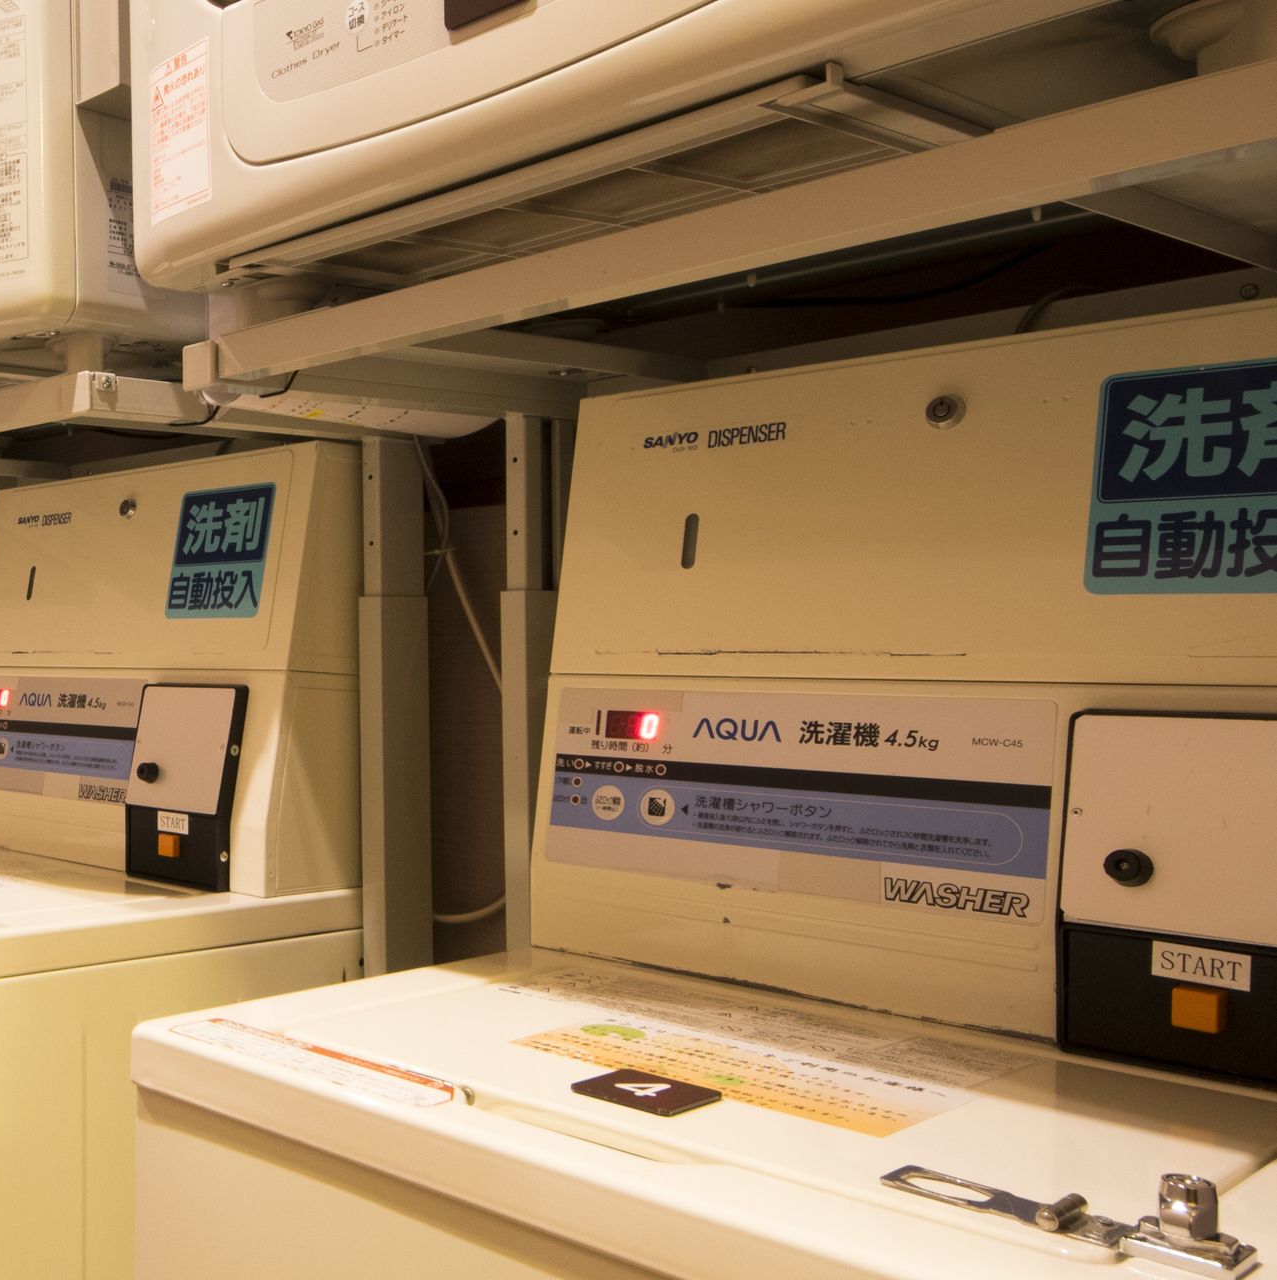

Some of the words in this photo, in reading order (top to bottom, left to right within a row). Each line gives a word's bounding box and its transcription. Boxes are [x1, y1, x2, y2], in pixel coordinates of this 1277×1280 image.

[348, 2, 365, 17] コース
[381, 3, 405, 19] アイロン
[293, 24, 312, 36] TOKYO
[313, 18, 324, 28] GAS
[381, 15, 408, 32] デリケート
[382, 30, 405, 45] タイマー
[271, 58, 308, 79] Clothes
[313, 41, 341, 60] Dryer
[643, 430, 699, 450] SANYO
[707, 422, 787, 448] DISPENSER
[17, 515, 40, 526] SANYO
[41, 511, 72, 527] DISPENSER
[183, 496, 267, 554] 洗剤
[168, 569, 258, 611] 自動投入
[19, 693, 52, 707] AQUA
[57, 694, 87, 708] 洗濯機
[87, 697, 107, 710] 4.5kg
[640, 713, 660, 740] 0
[692, 717, 782, 744] AQUA
[798, 721, 880, 749] 洗濯機
[884, 727, 940, 753] 4.5kg
[971, 736, 1023, 749] MCW-C45
[663, 744, 672, 754] 分
[695, 795, 832, 818] 洗濯槽シャワーボタン
[159, 815, 186, 830] START
[884, 876, 1029, 917] WASHER
[1160, 951, 1243, 983] START
[615, 1082, 671, 1097] 4
